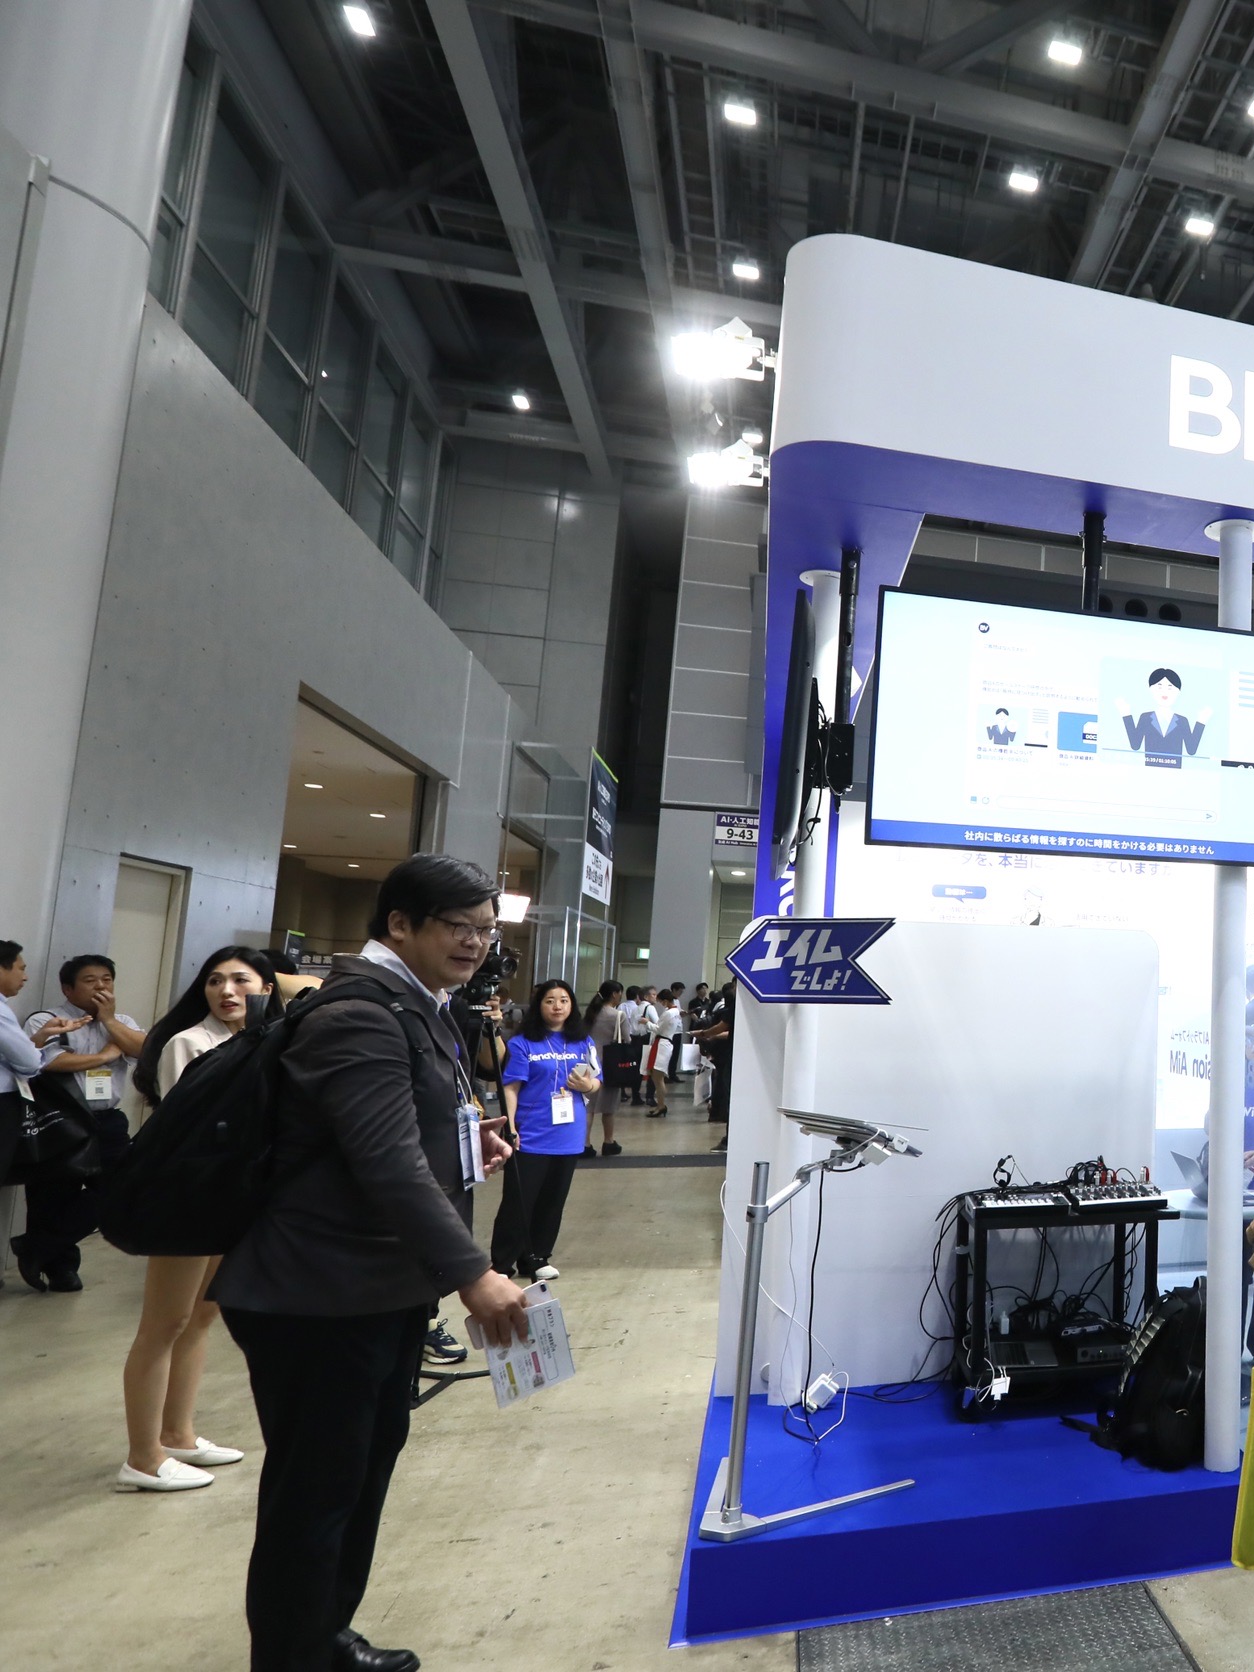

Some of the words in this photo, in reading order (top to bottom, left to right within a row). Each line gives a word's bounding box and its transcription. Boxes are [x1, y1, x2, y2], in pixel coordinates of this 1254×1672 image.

[726, 828, 753, 840] 9-43
[964, 830, 1215, 855] 社内に散らばる情報を探すのに時間をかける必要はありません
[751, 929, 843, 971] エイム
